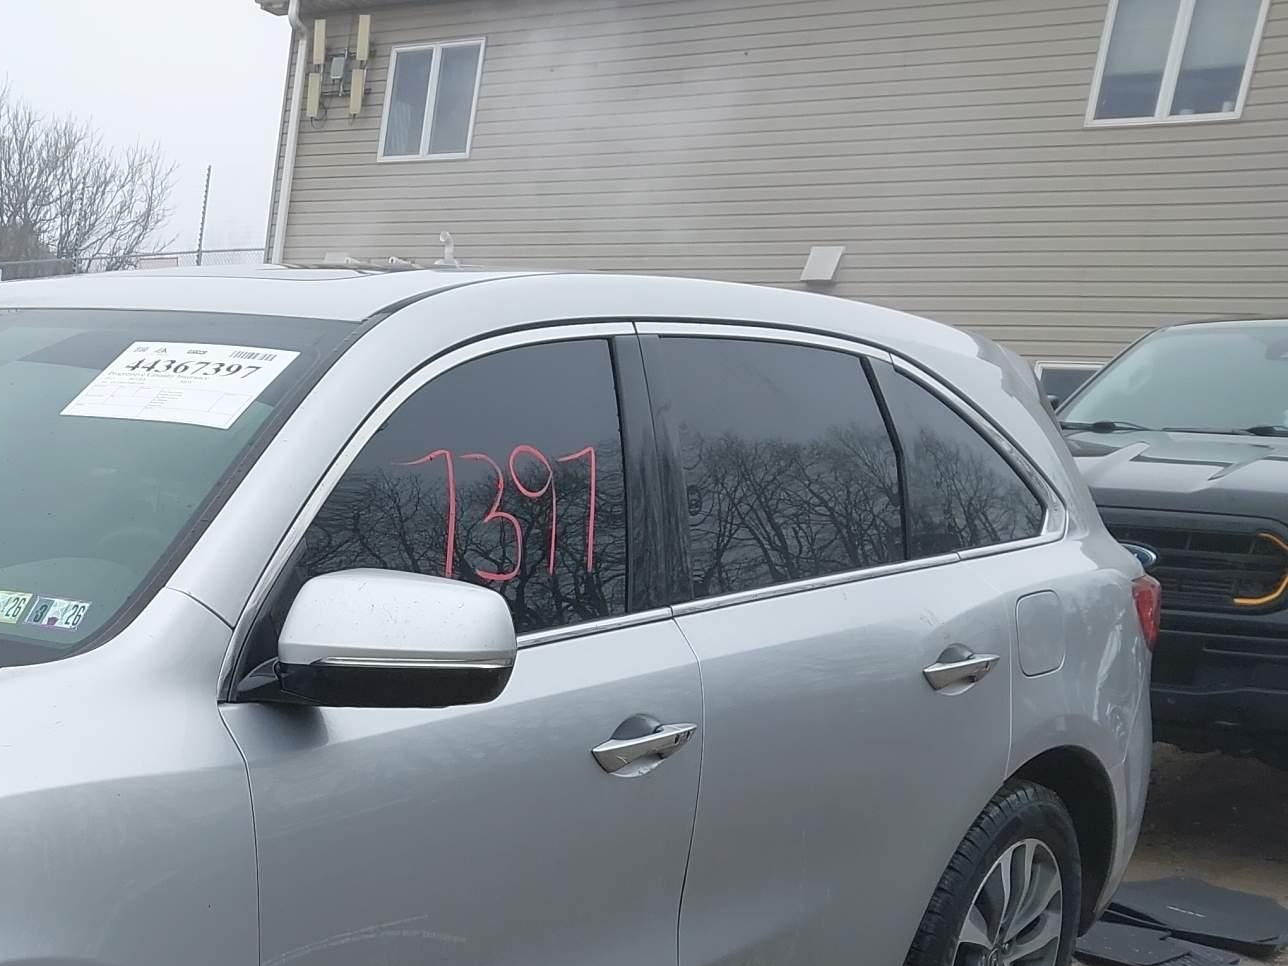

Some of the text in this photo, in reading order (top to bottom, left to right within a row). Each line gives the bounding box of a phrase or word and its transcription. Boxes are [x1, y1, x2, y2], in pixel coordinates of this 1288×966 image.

[125, 357, 263, 379] 44367397
[5, 596, 27, 618] 26
[33, 603, 86, 627] 3 26
